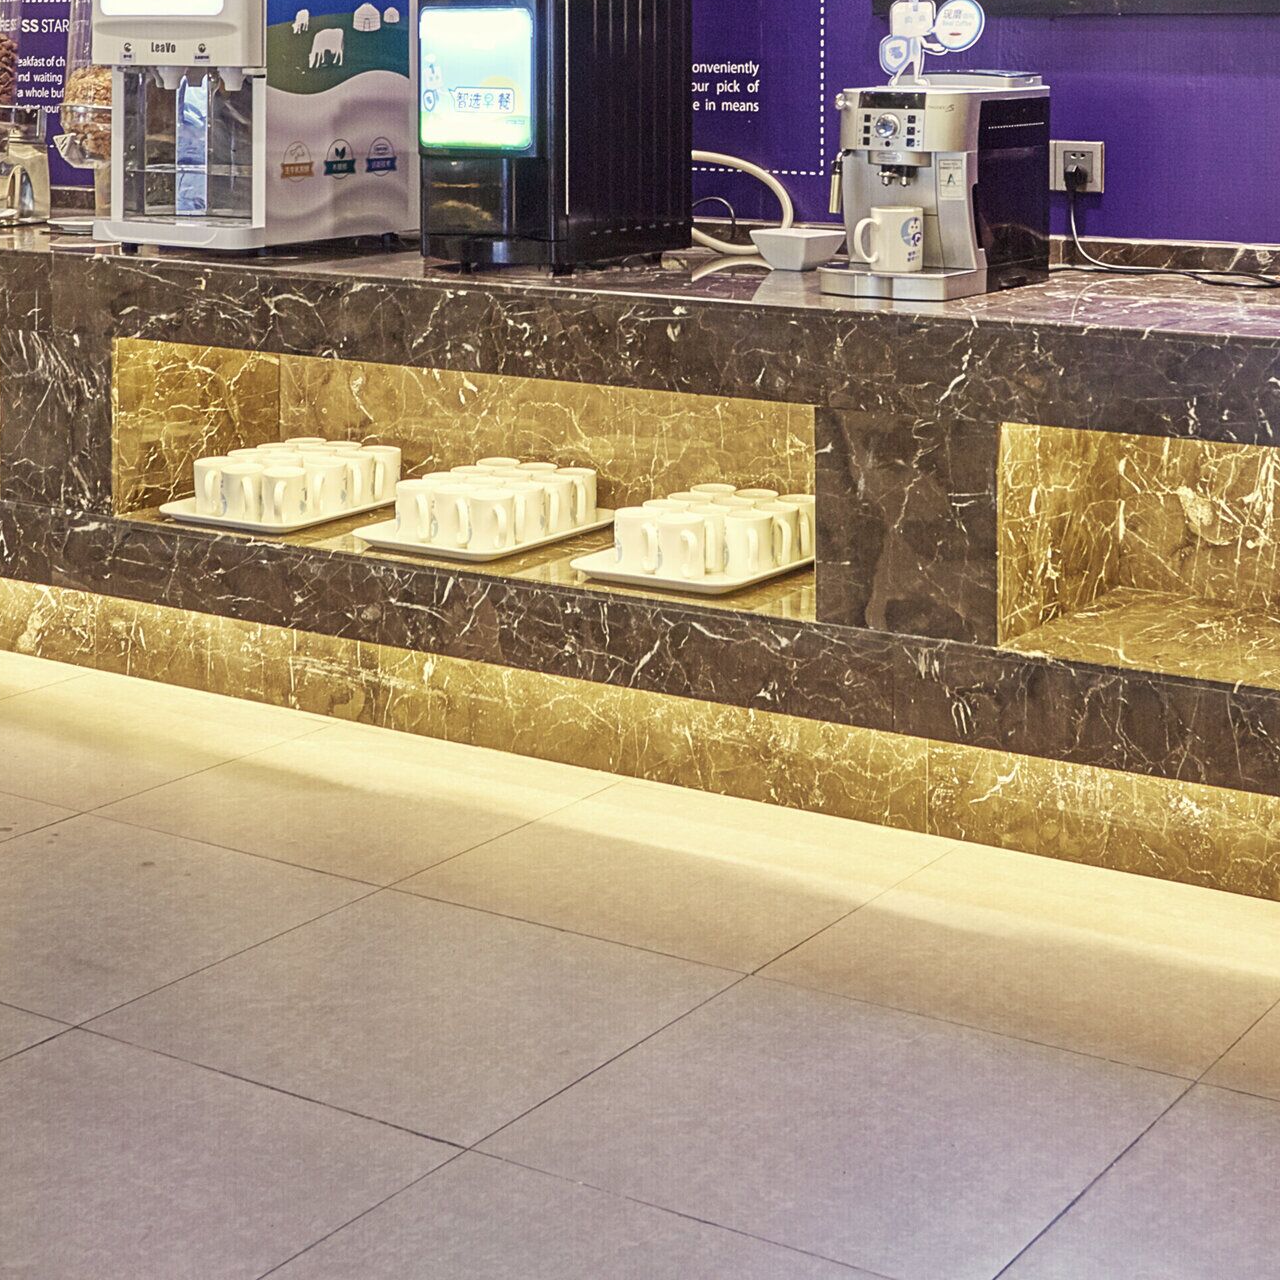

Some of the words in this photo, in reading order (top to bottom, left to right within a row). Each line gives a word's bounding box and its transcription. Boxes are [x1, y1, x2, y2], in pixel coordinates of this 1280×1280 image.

[46, 56, 54, 67] of
[55, 56, 66, 67] ch
[691, 60, 760, 77] onveniently
[33, 72, 63, 85] waiting
[25, 87, 49, 98] whole
[691, 82, 710, 93] our
[716, 80, 741, 96] pick
[746, 79, 761, 93] of
[704, 99, 717, 111] in
[721, 101, 760, 113] means
